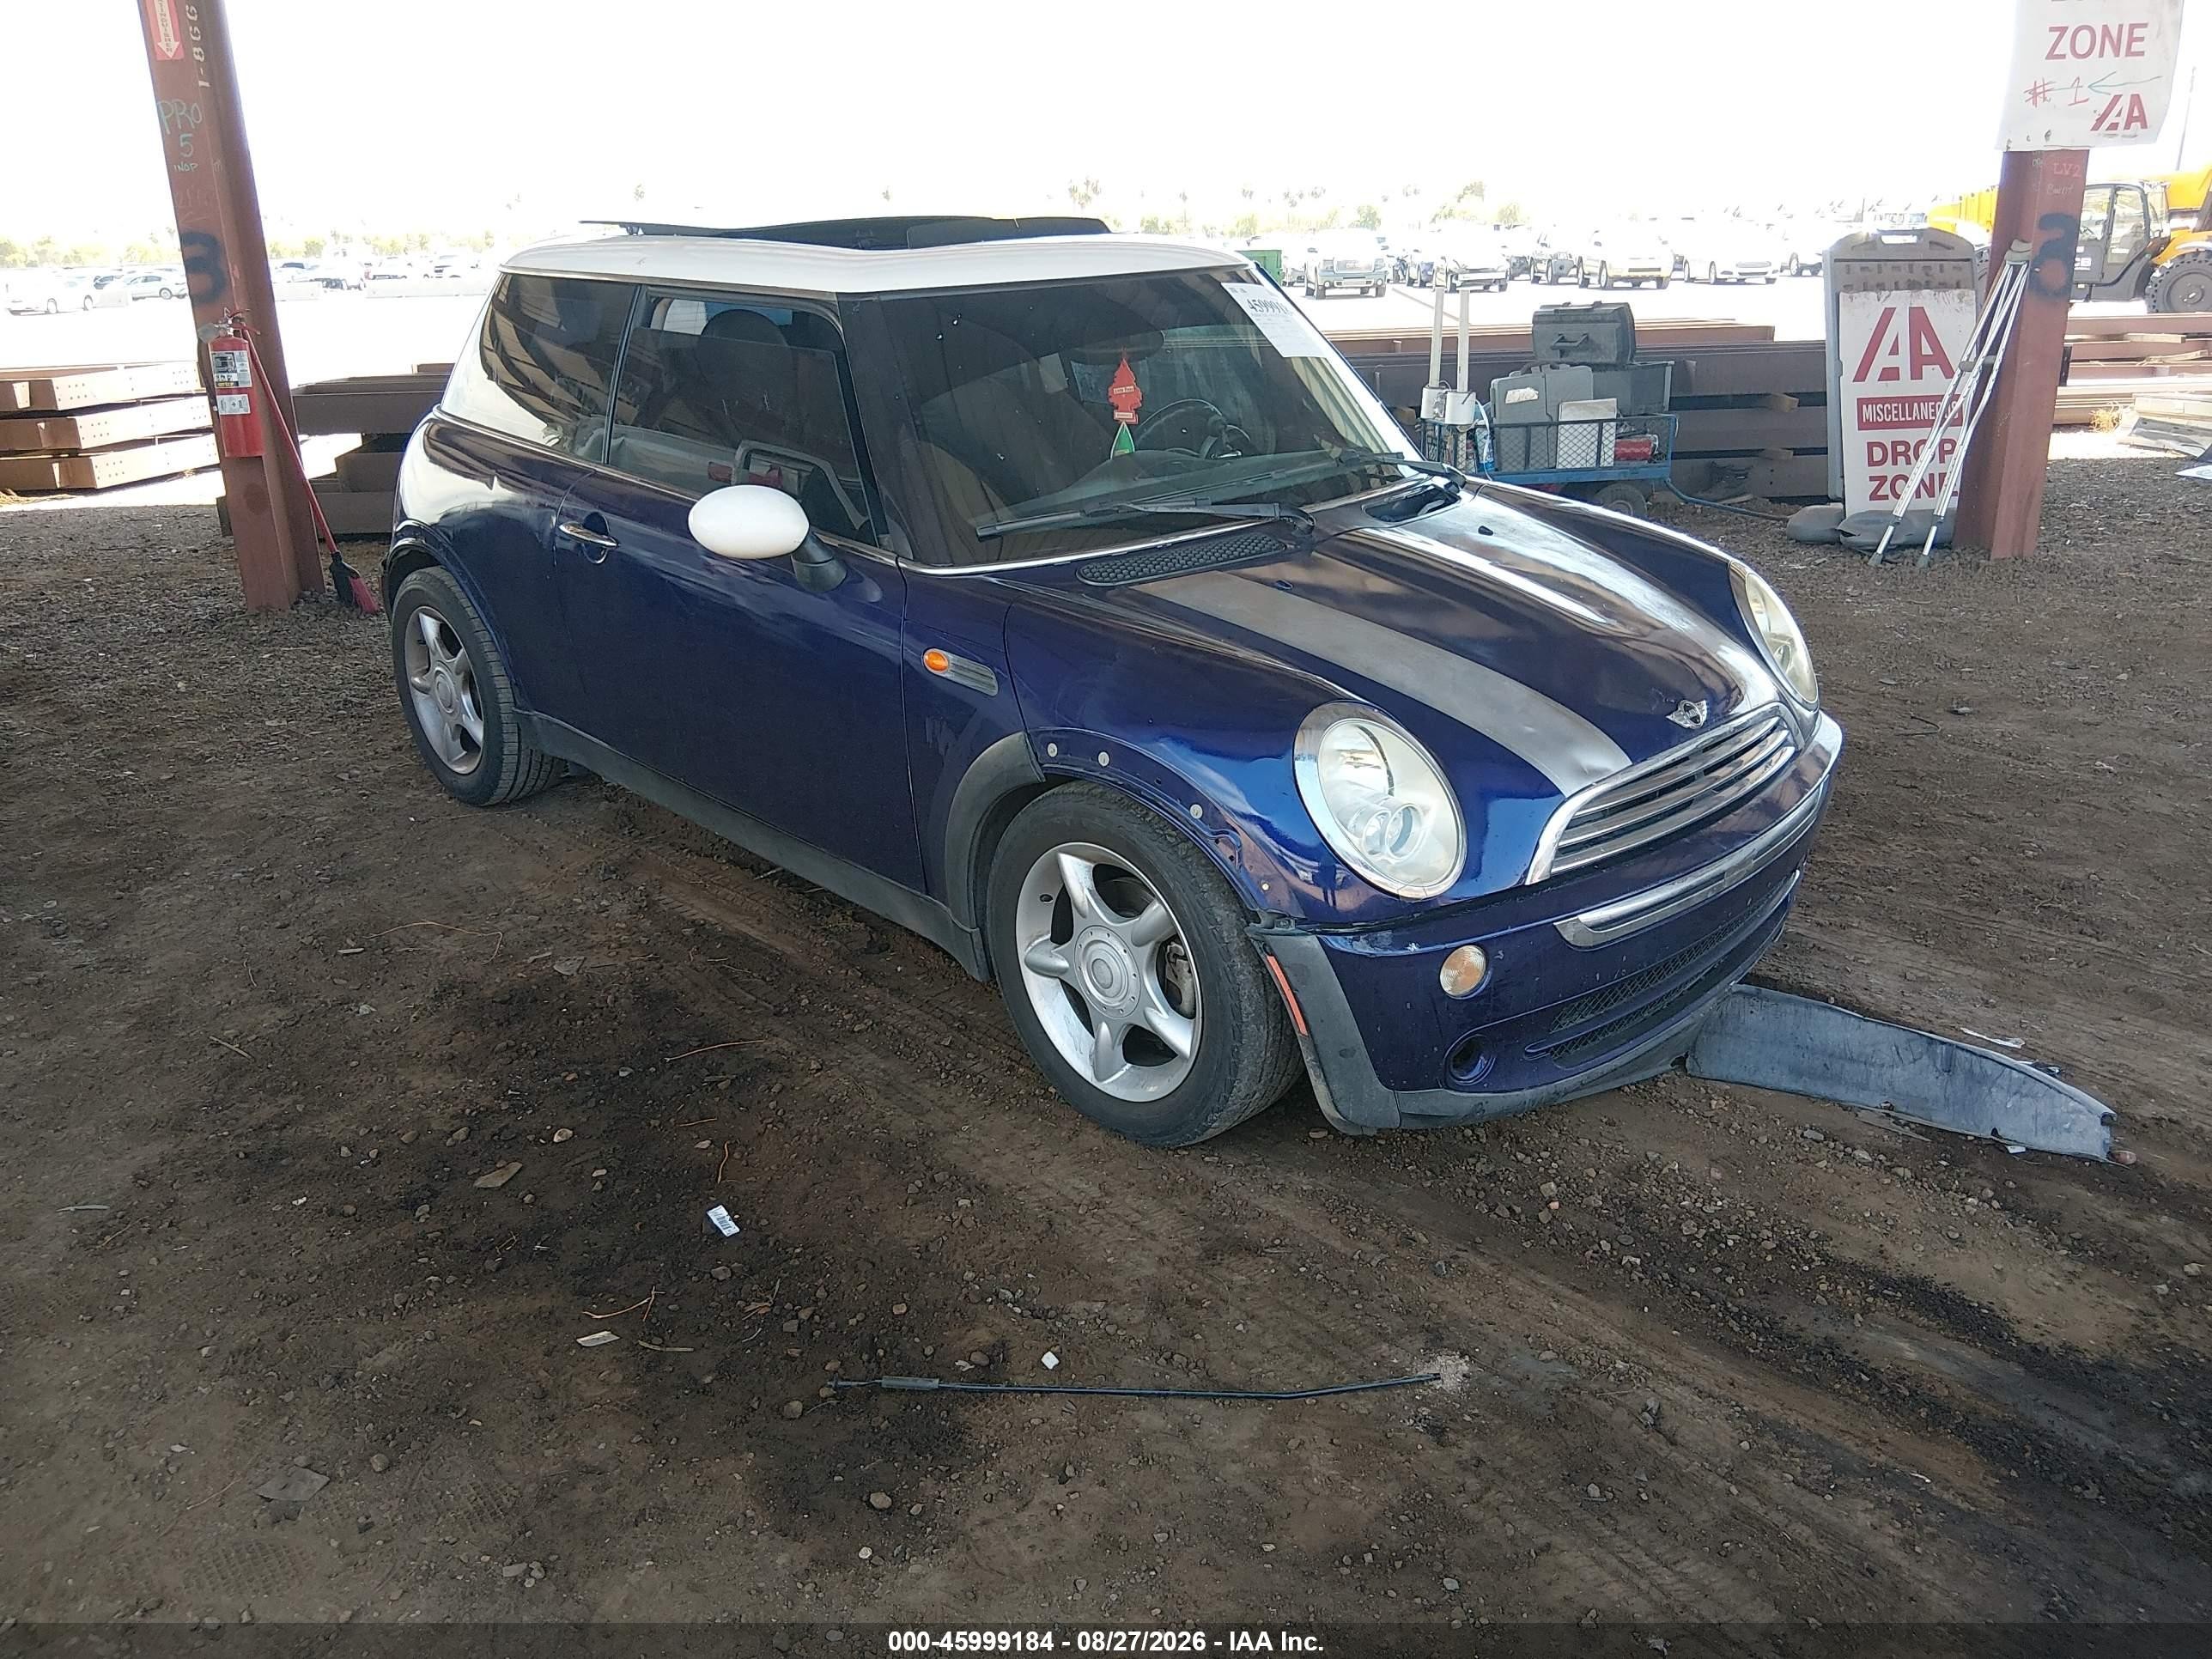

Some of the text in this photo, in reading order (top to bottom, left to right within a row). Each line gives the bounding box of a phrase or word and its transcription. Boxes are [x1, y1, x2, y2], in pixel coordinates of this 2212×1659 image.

[2045, 22, 2149, 60] ZONE
[157, 99, 204, 135] PRO
[179, 133, 194, 158] 5
